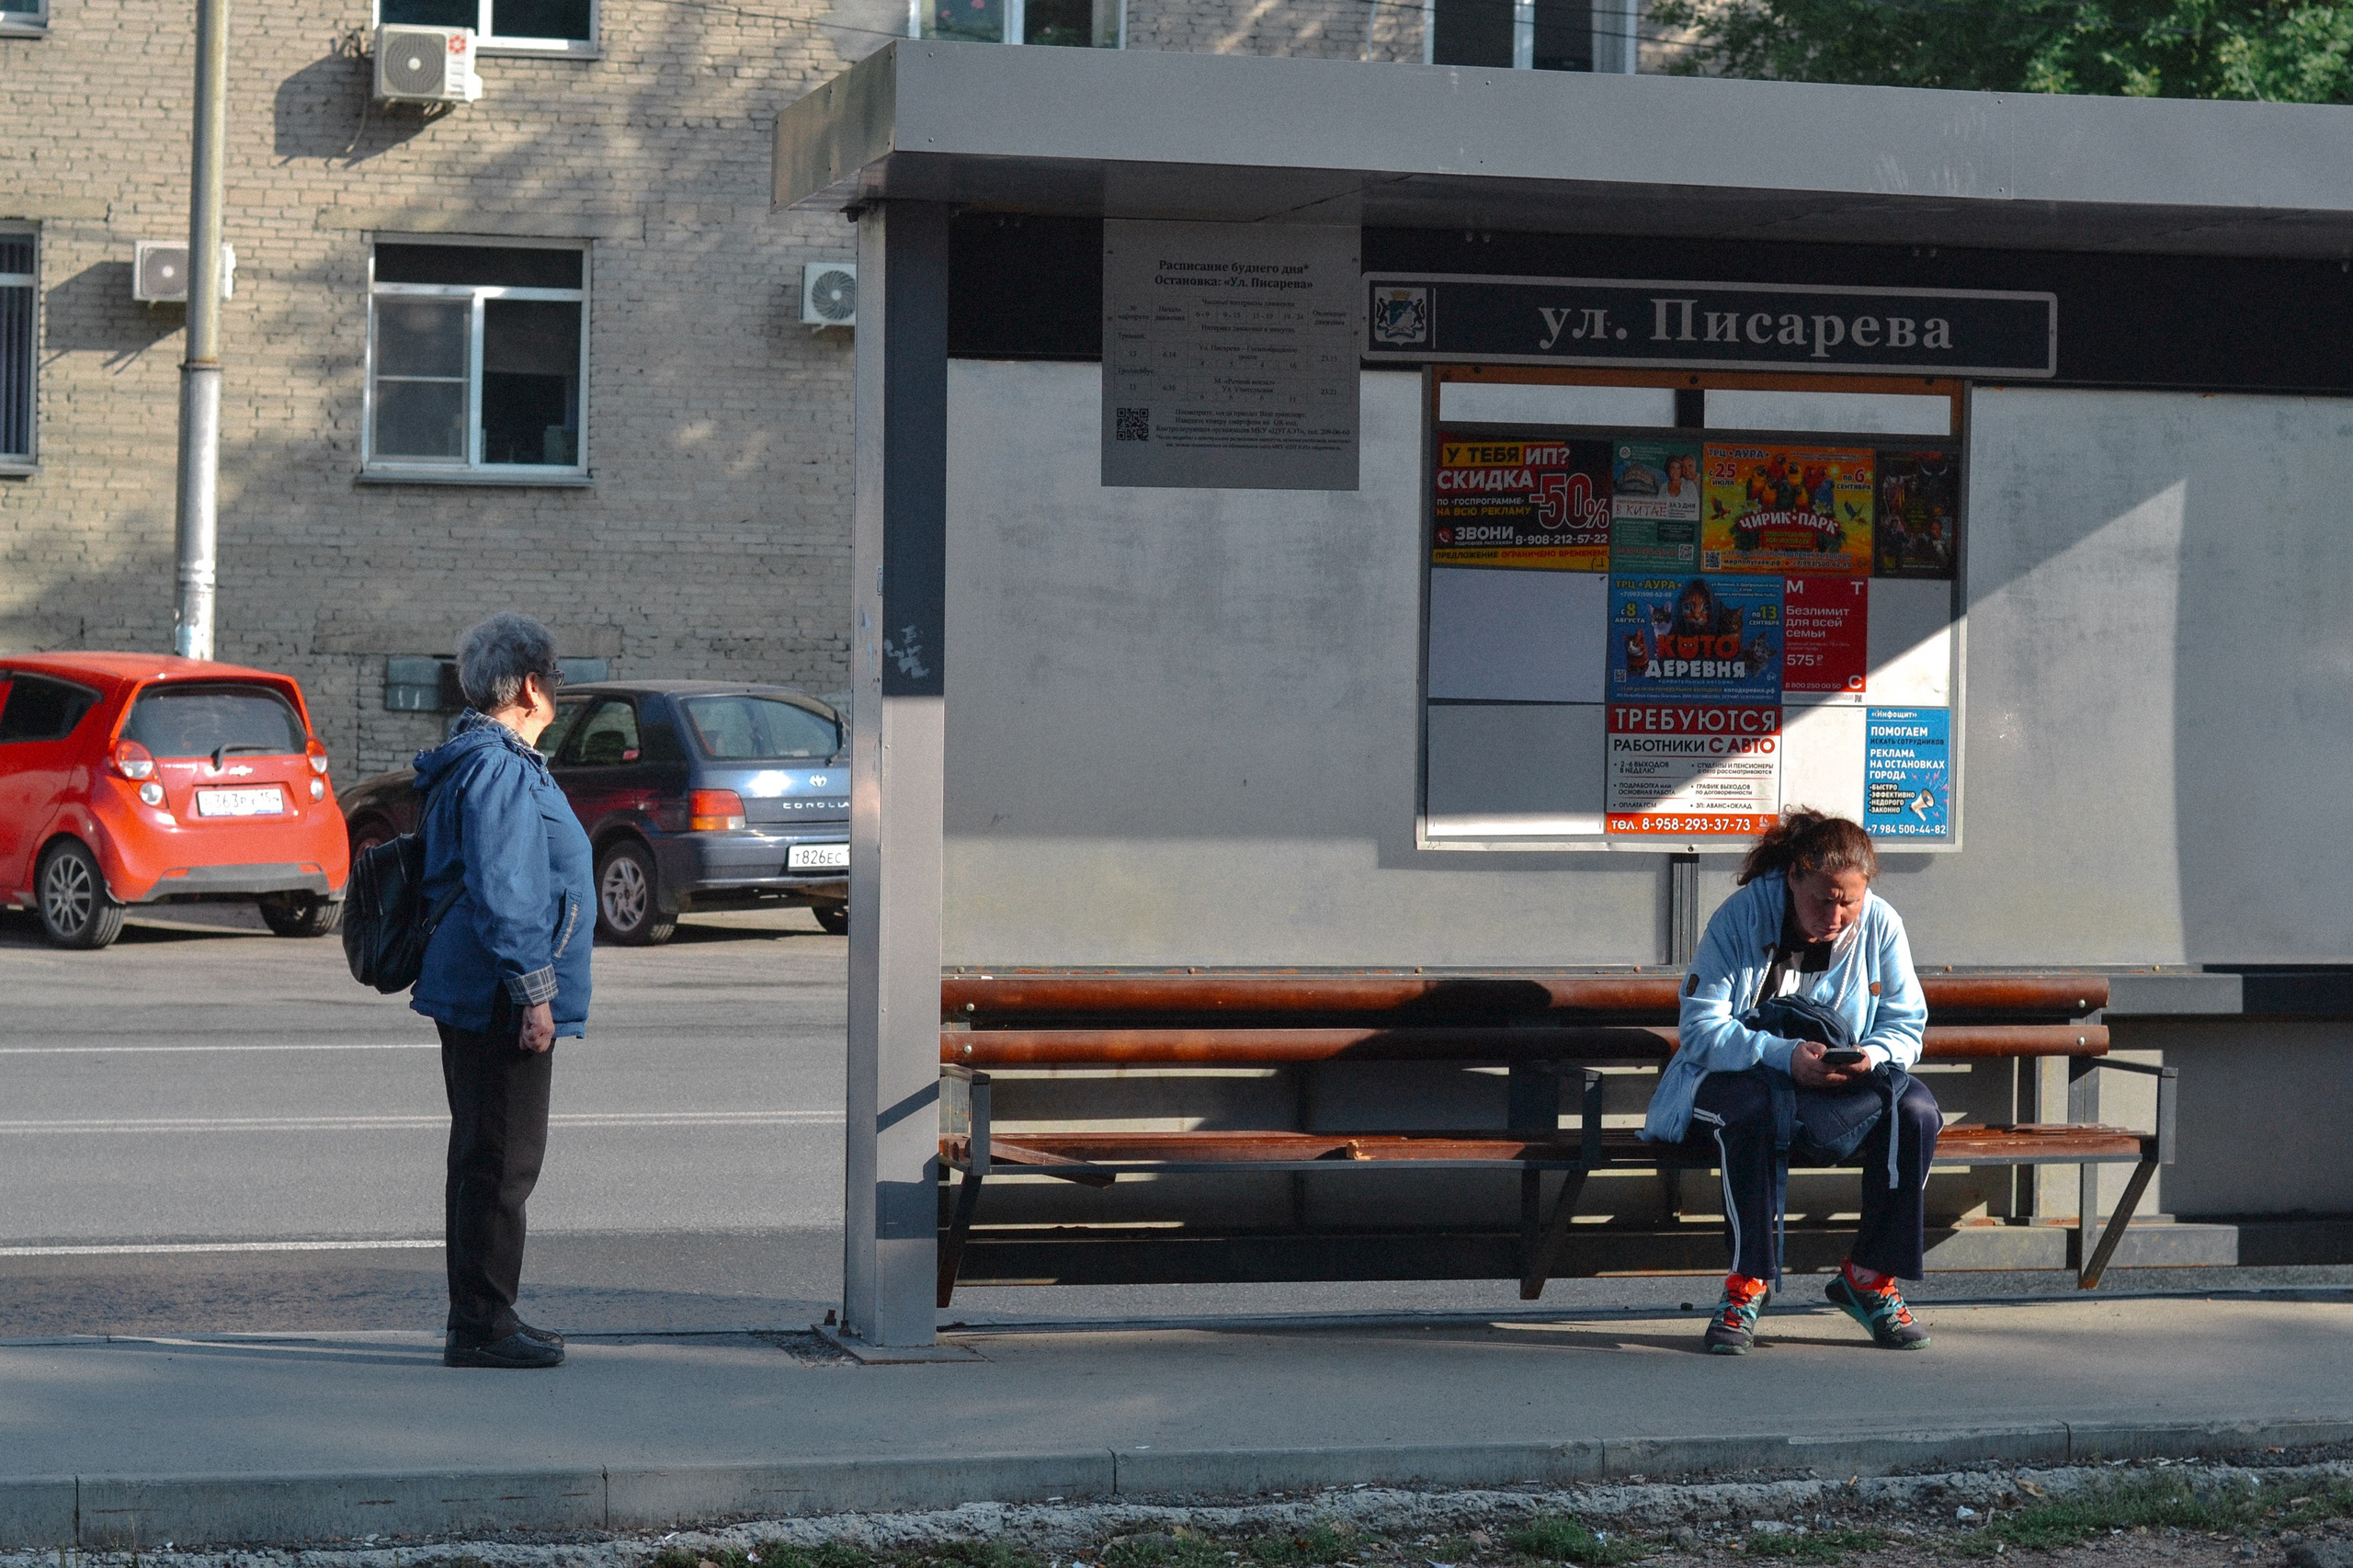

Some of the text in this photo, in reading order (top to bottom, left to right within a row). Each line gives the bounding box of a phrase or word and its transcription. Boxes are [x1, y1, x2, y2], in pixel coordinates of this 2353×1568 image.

[1159, 260, 1228, 272] Расписание
[1231, 263, 1279, 276] буднего
[1154, 275, 1221, 287] Остановка:
[1251, 278, 1313, 291] Писарева»
[1539, 298, 1954, 358] ул. Писарева
[1446, 447, 1570, 465] У ТЕБЯ ИП?
[1708, 449, 1727, 460] ТРЦ
[1715, 463, 1736, 479] 25
[1854, 467, 1866, 483] 6
[1437, 470, 1534, 493] СКИДКА
[1711, 479, 1735, 487] ИЮЛЯ
[1836, 483, 1872, 492] СЕНТЯБРЯ
[1529, 472, 1609, 530] -50%
[1437, 506, 1532, 517] НА ВСЮ РЕКЛАМУ
[1627, 505, 1667, 517] КИТАЕ
[1455, 526, 1515, 540] ЗВОНИ
[1516, 533, 1608, 546] 8-908-212-57-22
[1435, 551, 1499, 560] ПРЕДЛОЖЕНИЕ
[1501, 551, 1556, 559] ОГРАНИЧЕНО
[1615, 580, 1636, 590] ТРЦ
[1626, 602, 1637, 618] 8
[1760, 605, 1779, 619] 13
[1786, 606, 1850, 618] Безлимит
[1786, 617, 1843, 629] для всей
[1786, 630, 1826, 639] семьи
[1657, 634, 1742, 660] КОТО
[1787, 653, 1815, 666] 575
[1644, 659, 1745, 678] ДЕРЕВНЯ
[1615, 708, 1777, 733] ТРЕБУЮТСЯ
[1870, 726, 1928, 737] ПОМОГАЕМ
[1613, 737, 1777, 754] РАБОТНИКИ С АВТО
[1897, 738, 1945, 746] СОТРУДНИКОВ
[1870, 748, 1915, 758] РЕКЛАМА
[1634, 761, 1669, 769] ВЫХОДОВ
[1697, 762, 1726, 770] СТУДЕНТЫ
[1870, 759, 1946, 769] НА ОСТАНОВКАХ
[1717, 768, 1772, 777] рассматриваются
[1870, 770, 1906, 781] ГОРОДА
[1619, 782, 1659, 790] ПОДРАБОТКА
[1697, 783, 1719, 791] ГРАФИК
[1619, 801, 1658, 810] ОПЛАТА ГСМ
[1706, 801, 1753, 811] АВАНС+ОКЛАД
[1611, 816, 1752, 832] тел. 8-958-293-37-73
[1866, 824, 1948, 835] +7 984 500-44-82
